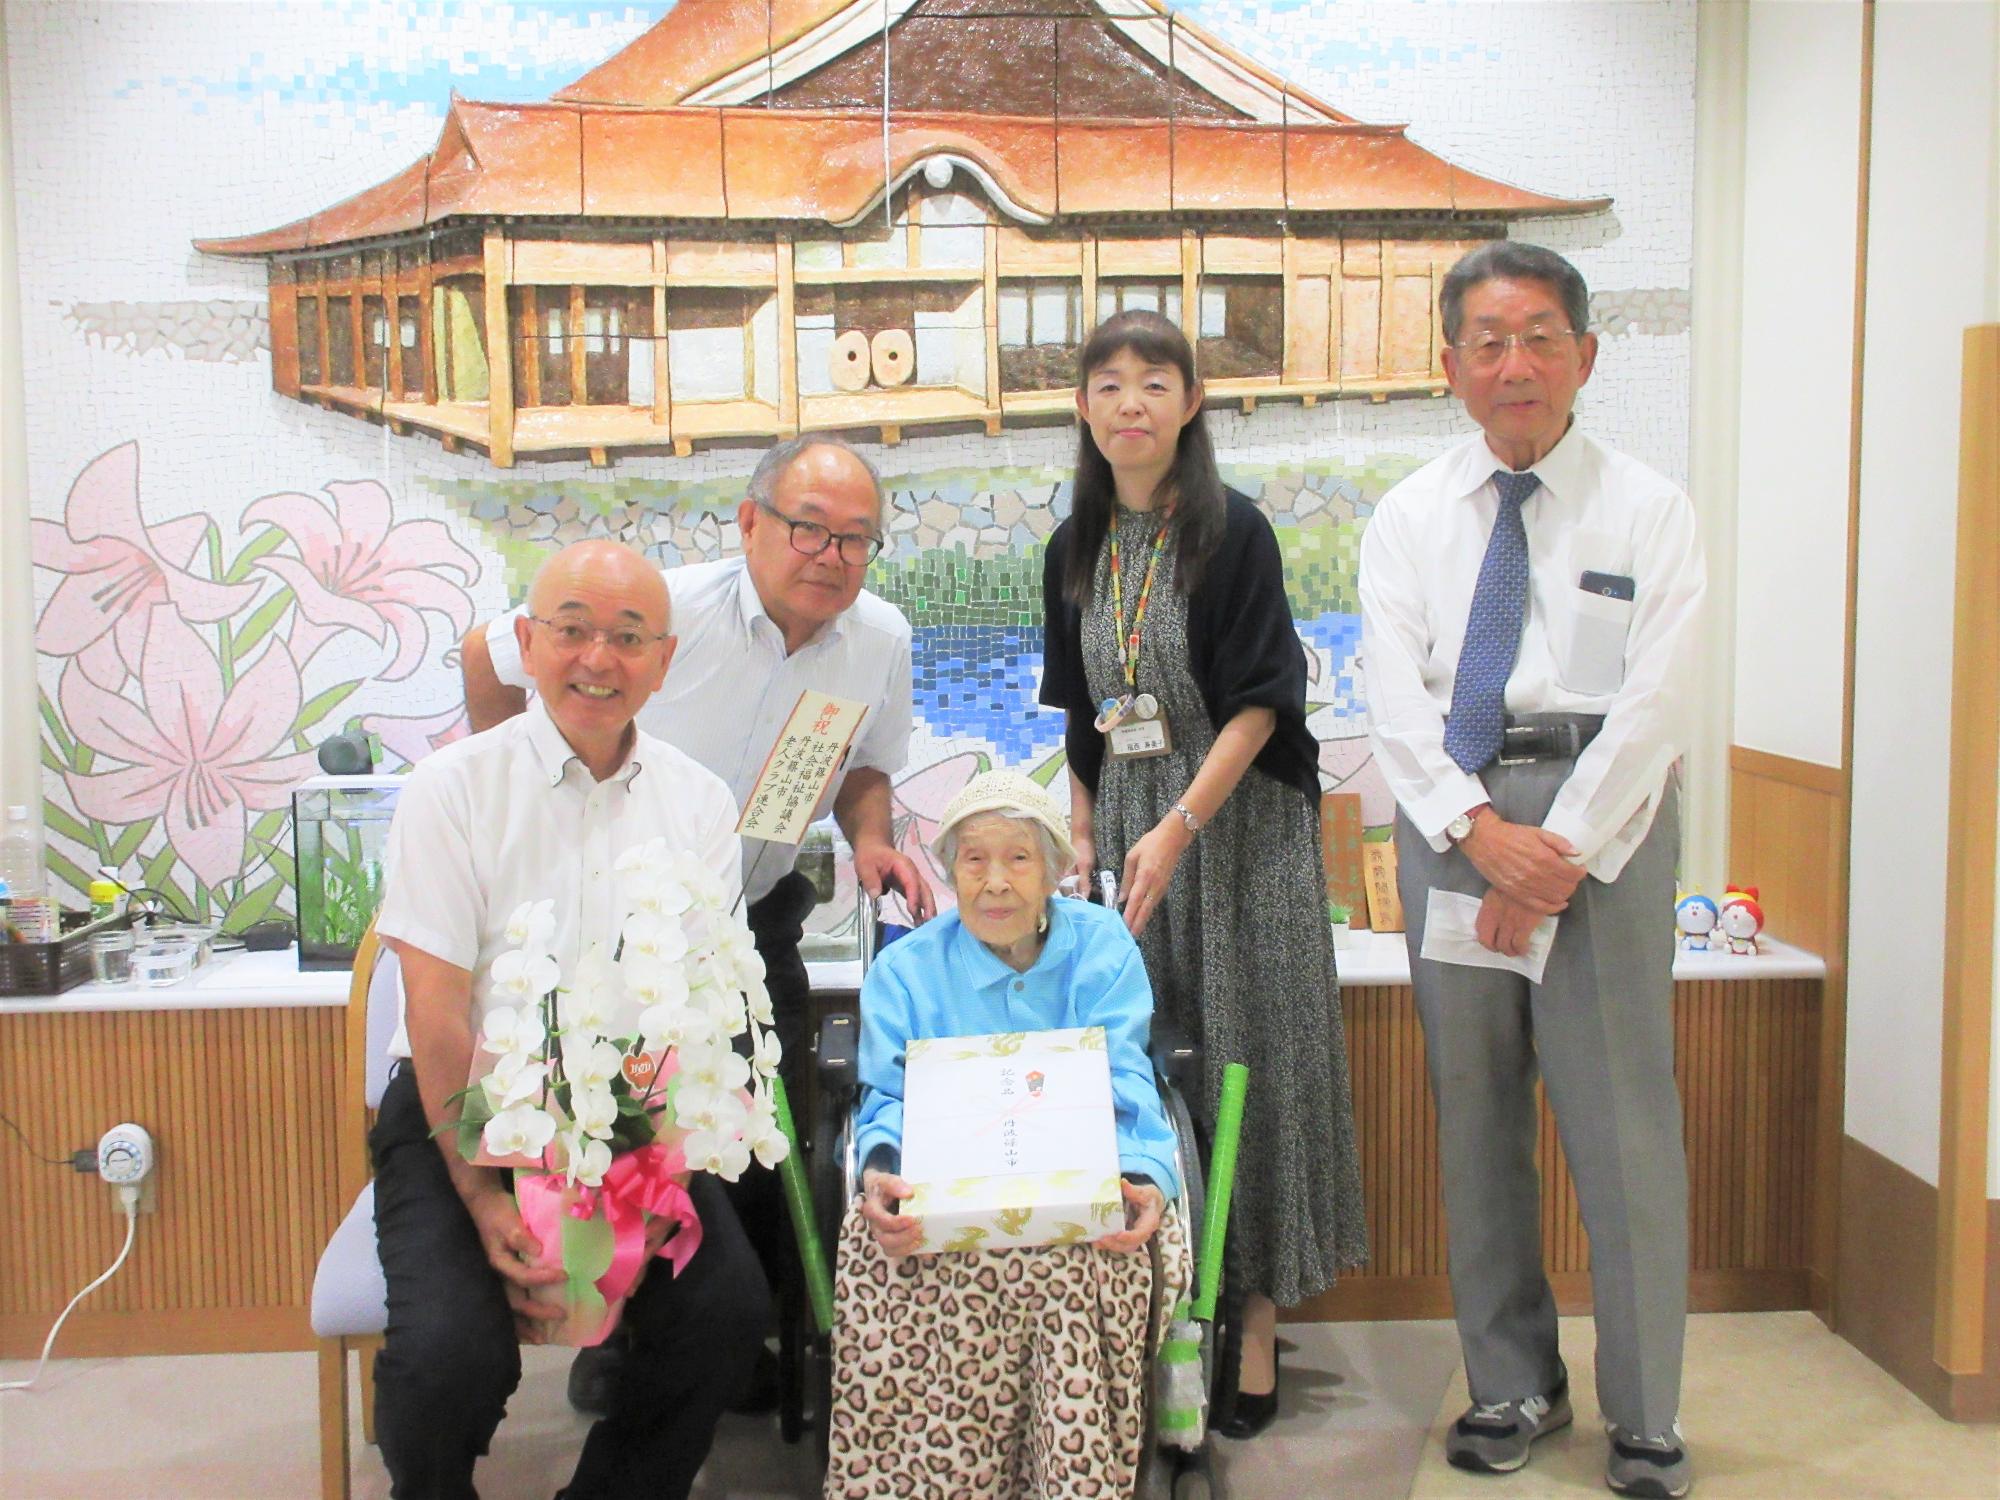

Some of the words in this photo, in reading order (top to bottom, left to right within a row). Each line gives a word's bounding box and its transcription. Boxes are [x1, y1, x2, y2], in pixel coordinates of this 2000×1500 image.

[812, 701, 841, 736] 御祝
[745, 735, 797, 829] 老人クラブ連合会
[774, 741, 825, 834] 社会福祉協議会
[776, 736, 812, 799] 丹波篠山市
[803, 742, 839, 804] 丹波篠山市
[1000, 1067, 1016, 1096] 記念品
